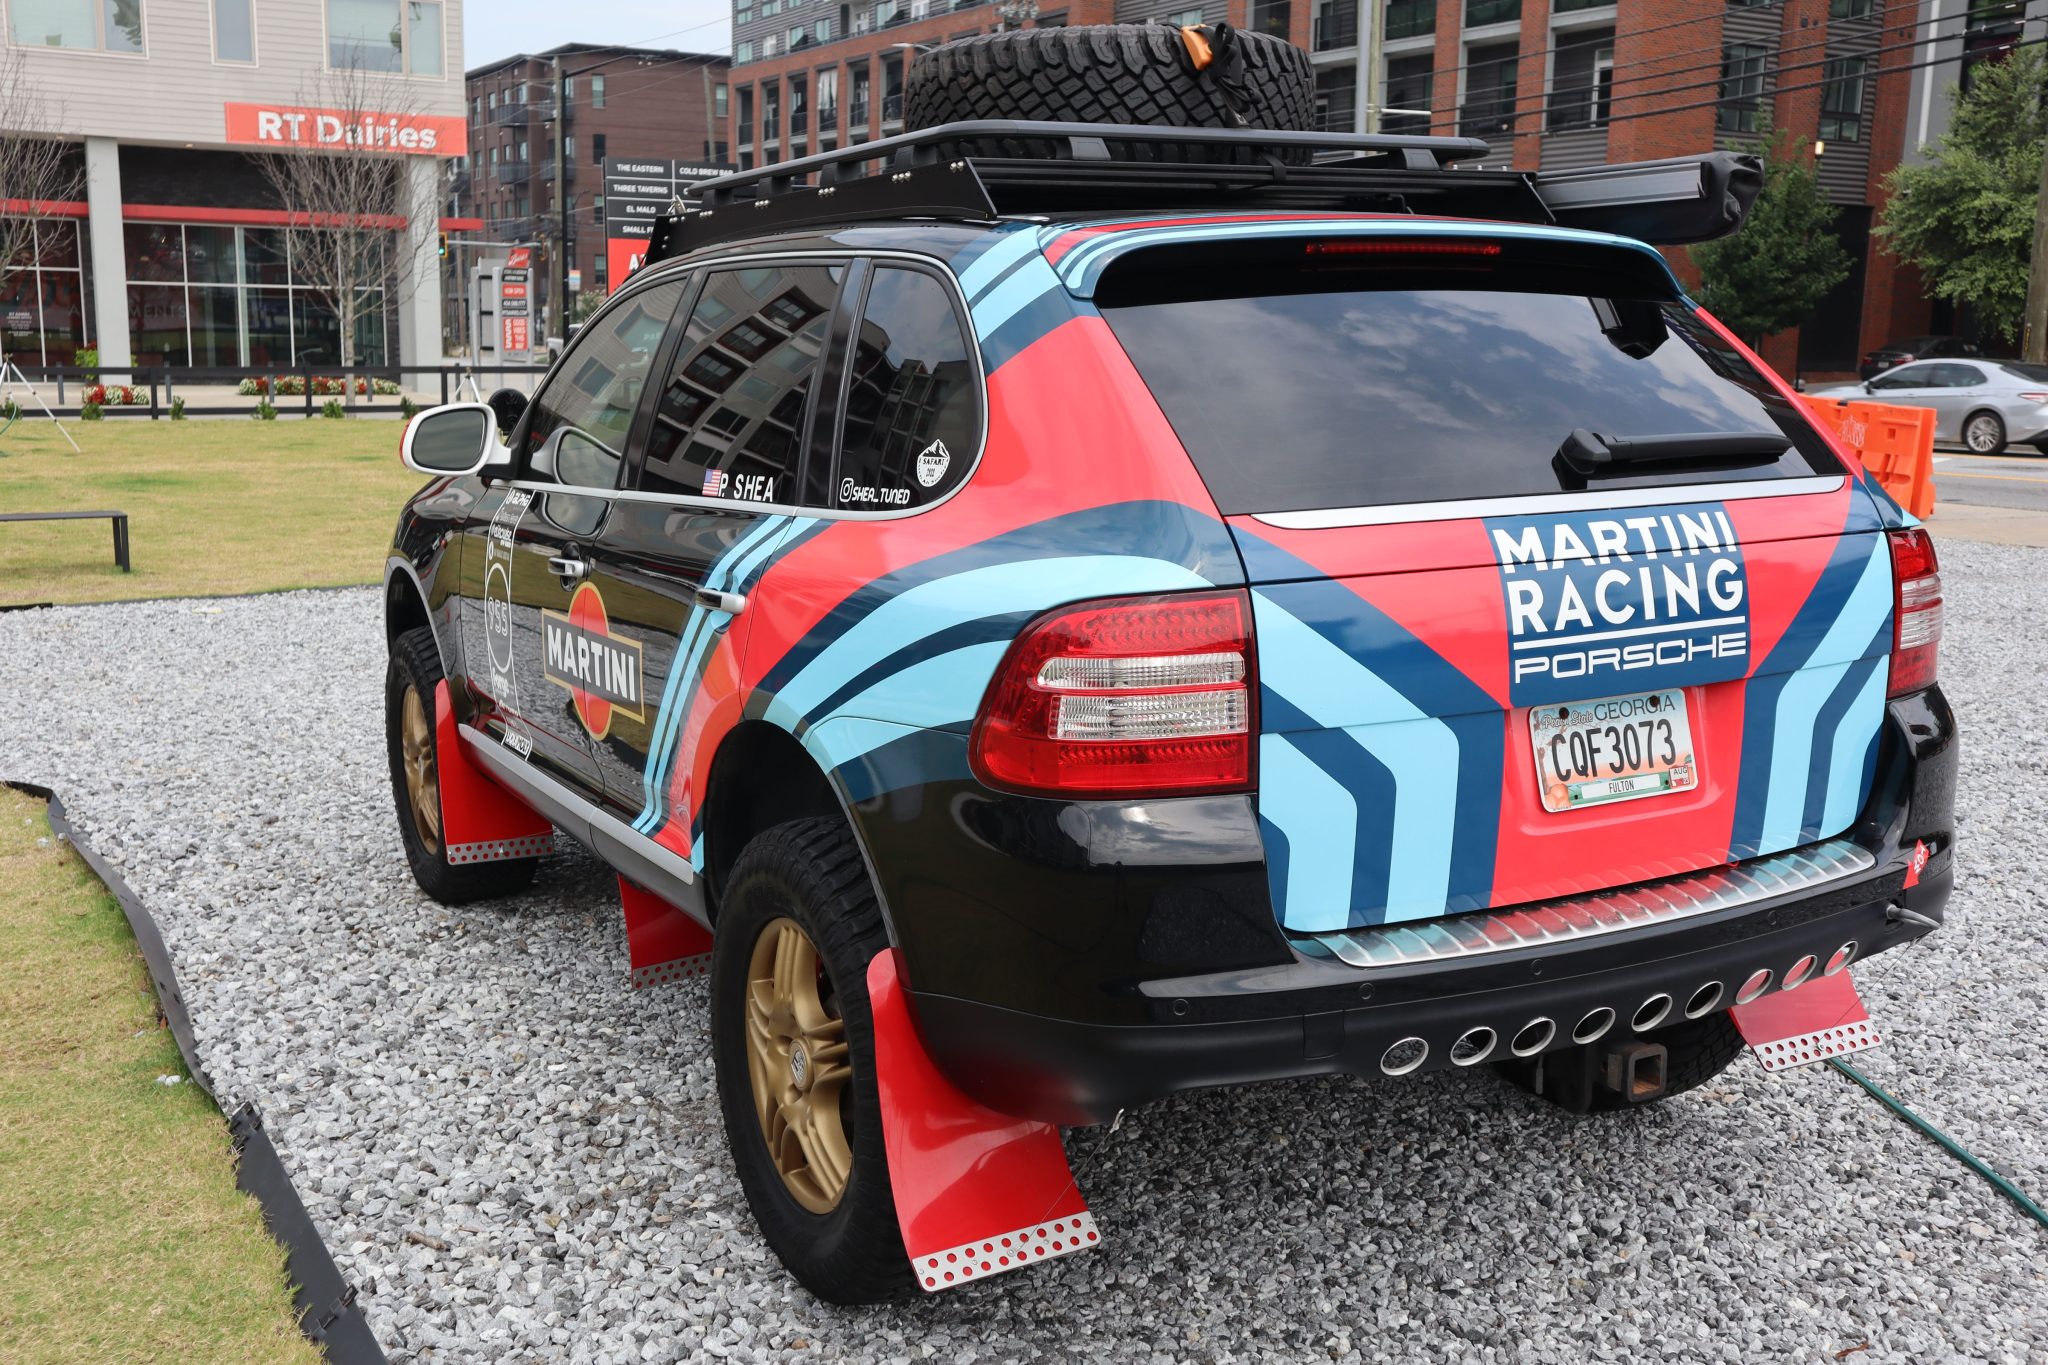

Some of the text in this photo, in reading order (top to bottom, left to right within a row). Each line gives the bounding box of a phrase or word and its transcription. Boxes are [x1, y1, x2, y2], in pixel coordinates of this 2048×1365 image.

[257, 110, 437, 150] RT Dairies
[617, 164, 664, 174] THE EASTERN
[679, 166, 698, 175] COLD
[698, 168, 719, 176] BREW
[613, 184, 669, 194] THREE TAVERNS
[626, 205, 656, 214] EL MALO
[622, 225, 646, 234] SMALL
[922, 457, 945, 466] SAFARI
[734, 473, 774, 503] SHEA
[1492, 511, 1738, 574] MARTINI
[1506, 558, 1743, 636] RACING
[547, 624, 636, 702] MARTINI
[1514, 632, 1746, 684] PORSCHE
[1571, 709, 1594, 725] State
[1593, 694, 1676, 721] GEORGIA
[1551, 718, 1677, 782] CQF3073
[1673, 766, 1688, 776] AUG
[1608, 779, 1635, 794] FULTON
[1914, 845, 1926, 874] TOW
